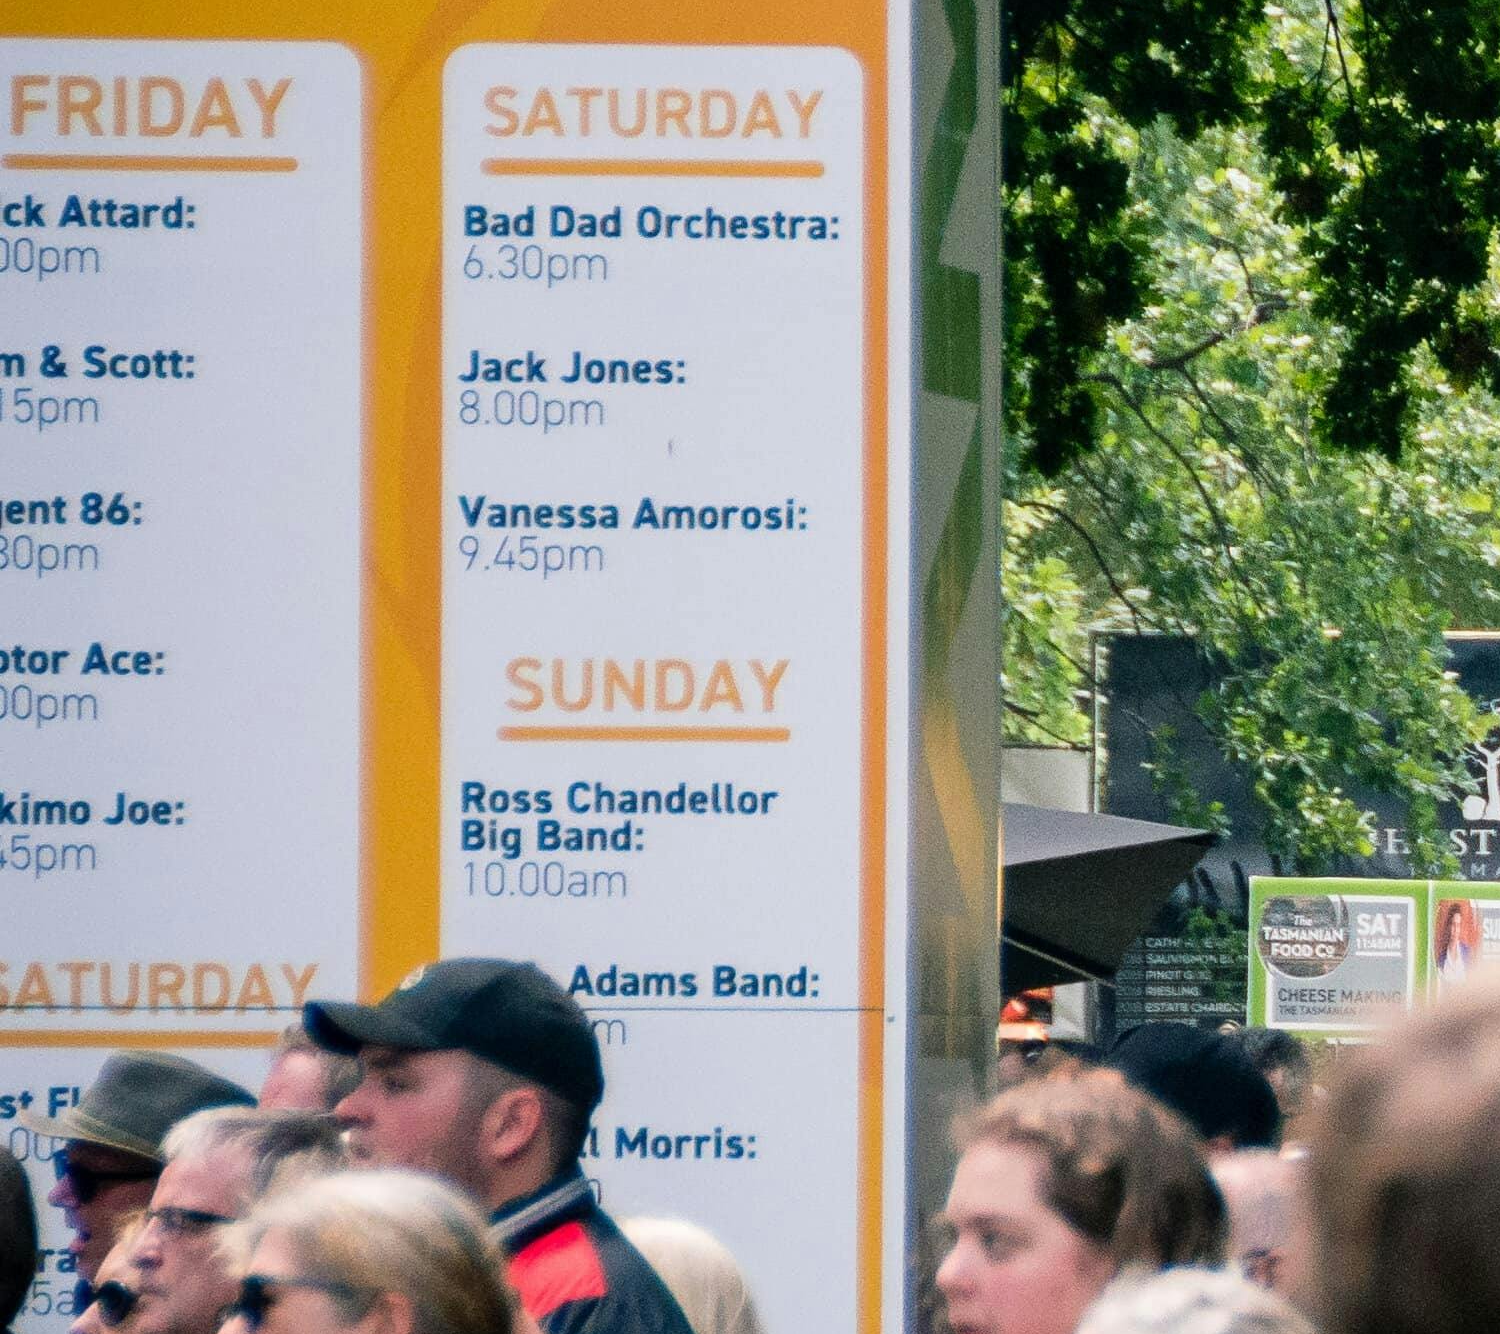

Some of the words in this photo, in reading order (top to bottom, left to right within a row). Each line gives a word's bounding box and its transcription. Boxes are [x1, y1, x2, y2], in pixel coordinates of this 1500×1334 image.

[9, 75, 294, 139] FRIDAY
[483, 85, 824, 139] SATURDAY
[58, 194, 196, 229] Attard:
[463, 204, 535, 238] Bad
[549, 205, 622, 238] Dad
[636, 205, 840, 241] Orchestra:
[463, 243, 608, 288] 6.30pm
[39, 345, 68, 378] &
[83, 345, 195, 379] Scott:
[457, 349, 547, 384] Jack
[560, 350, 687, 385] Jones:
[459, 390, 604, 434] 8.00pm
[0, 496, 67, 529] ent
[80, 492, 142, 526] 86:
[457, 495, 619, 530] Vanessa
[632, 497, 808, 531] Amorosi:
[459, 535, 604, 579] 9.45pm
[80, 642, 165, 675] Ace:
[504, 656, 791, 713] SUNDAY
[103, 792, 186, 825] Joe:
[460, 781, 553, 814] Ross
[566, 781, 780, 815] Chandellor
[460, 818, 523, 860] Big
[536, 819, 645, 852] Band:
[463, 861, 628, 898] 10.00am
[1262, 927, 1343, 942] TASMANIAN
[1293, 915, 1313, 927] The
[1357, 913, 1401, 935] SAT
[1271, 943, 1312, 958] FOOD
[0, 962, 319, 1016] ATURDAY
[568, 963, 698, 997] Adams
[712, 964, 820, 998] Band:
[1145, 986, 1200, 996] RIESLING
[1278, 988, 1336, 1003] CHEESE
[615, 1126, 757, 1159] Morris:
